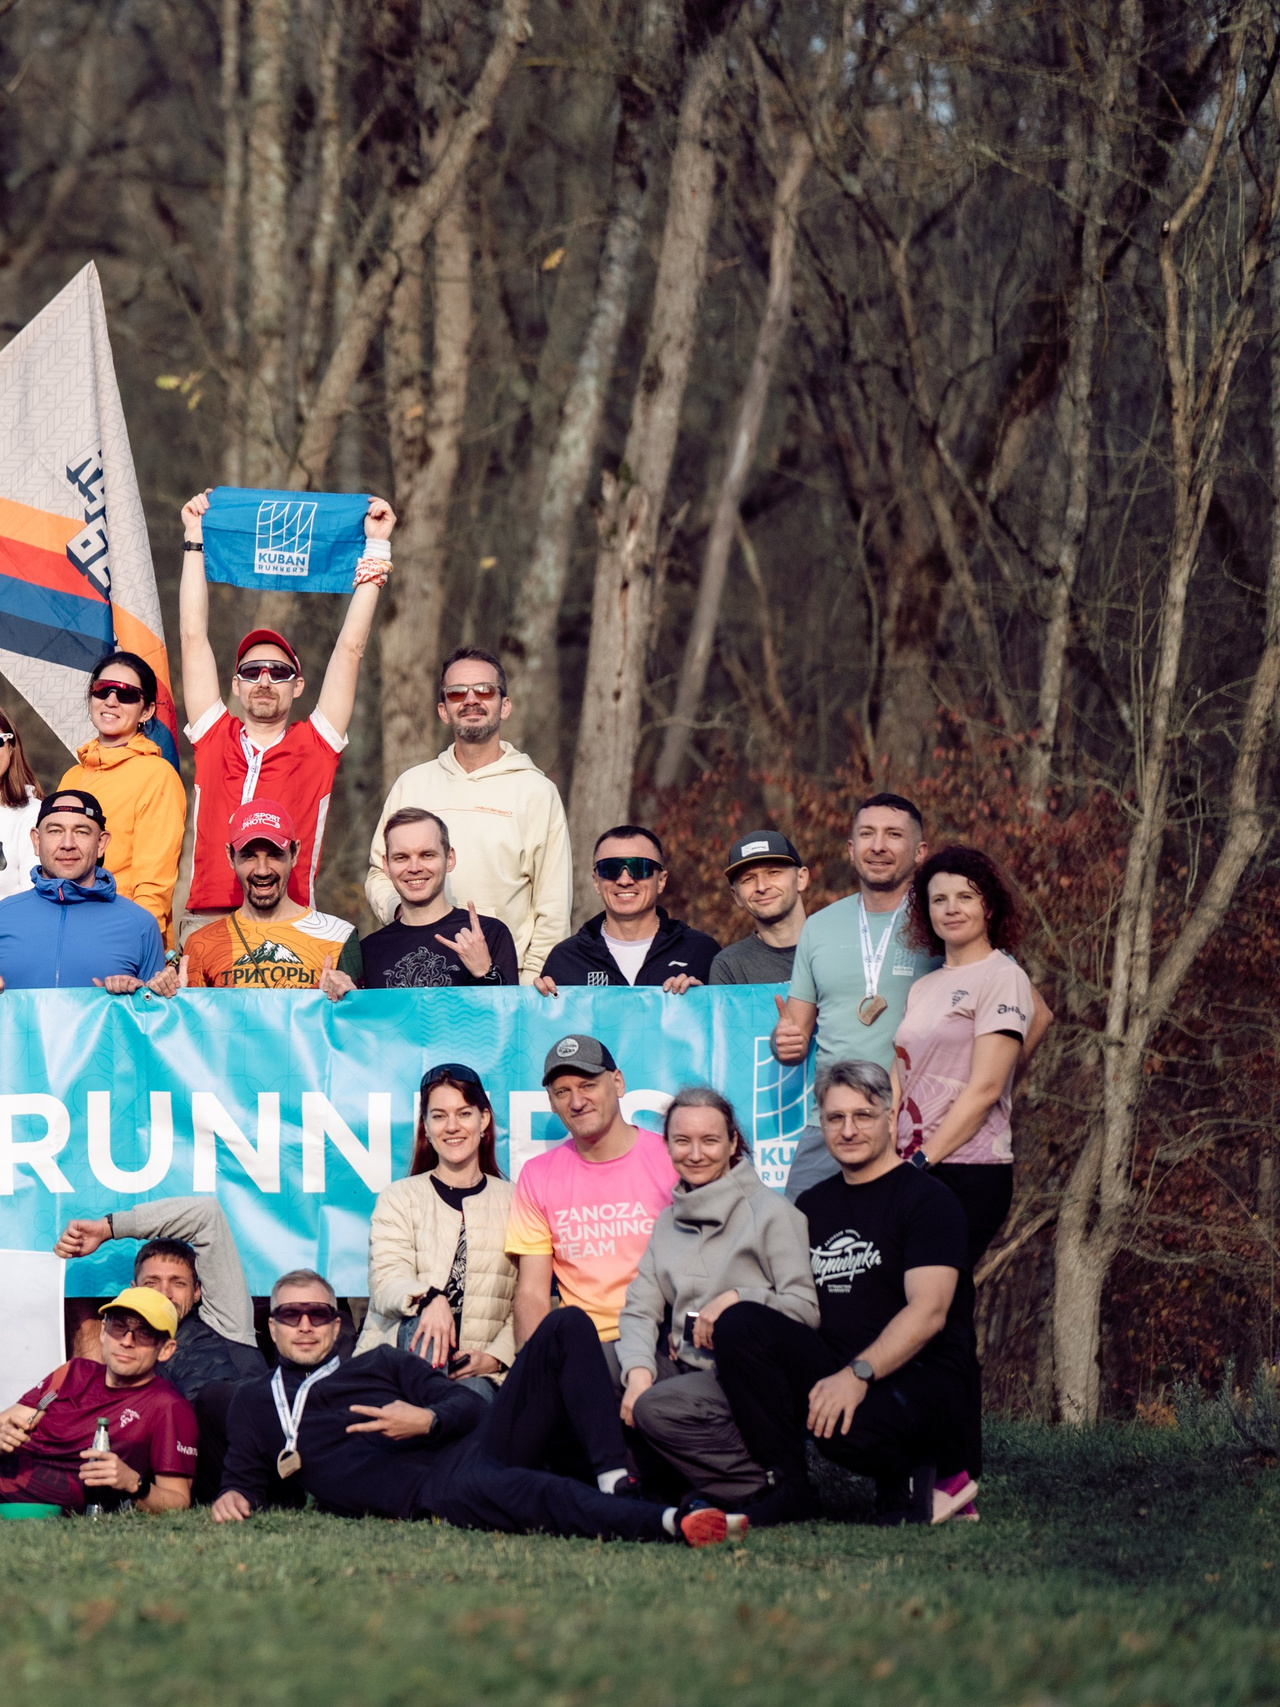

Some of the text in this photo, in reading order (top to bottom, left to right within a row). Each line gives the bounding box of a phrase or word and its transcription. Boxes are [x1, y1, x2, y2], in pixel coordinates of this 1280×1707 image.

[258, 553, 306, 566] KUBAN
[258, 564, 305, 573] RUNNERS
[253, 812, 281, 822] SPORT
[221, 966, 315, 985] ТРИГОРЫ
[555, 1202, 648, 1228] ZANOZA
[558, 1218, 654, 1244] RUNNING
[558, 1240, 616, 1260] TEAM
